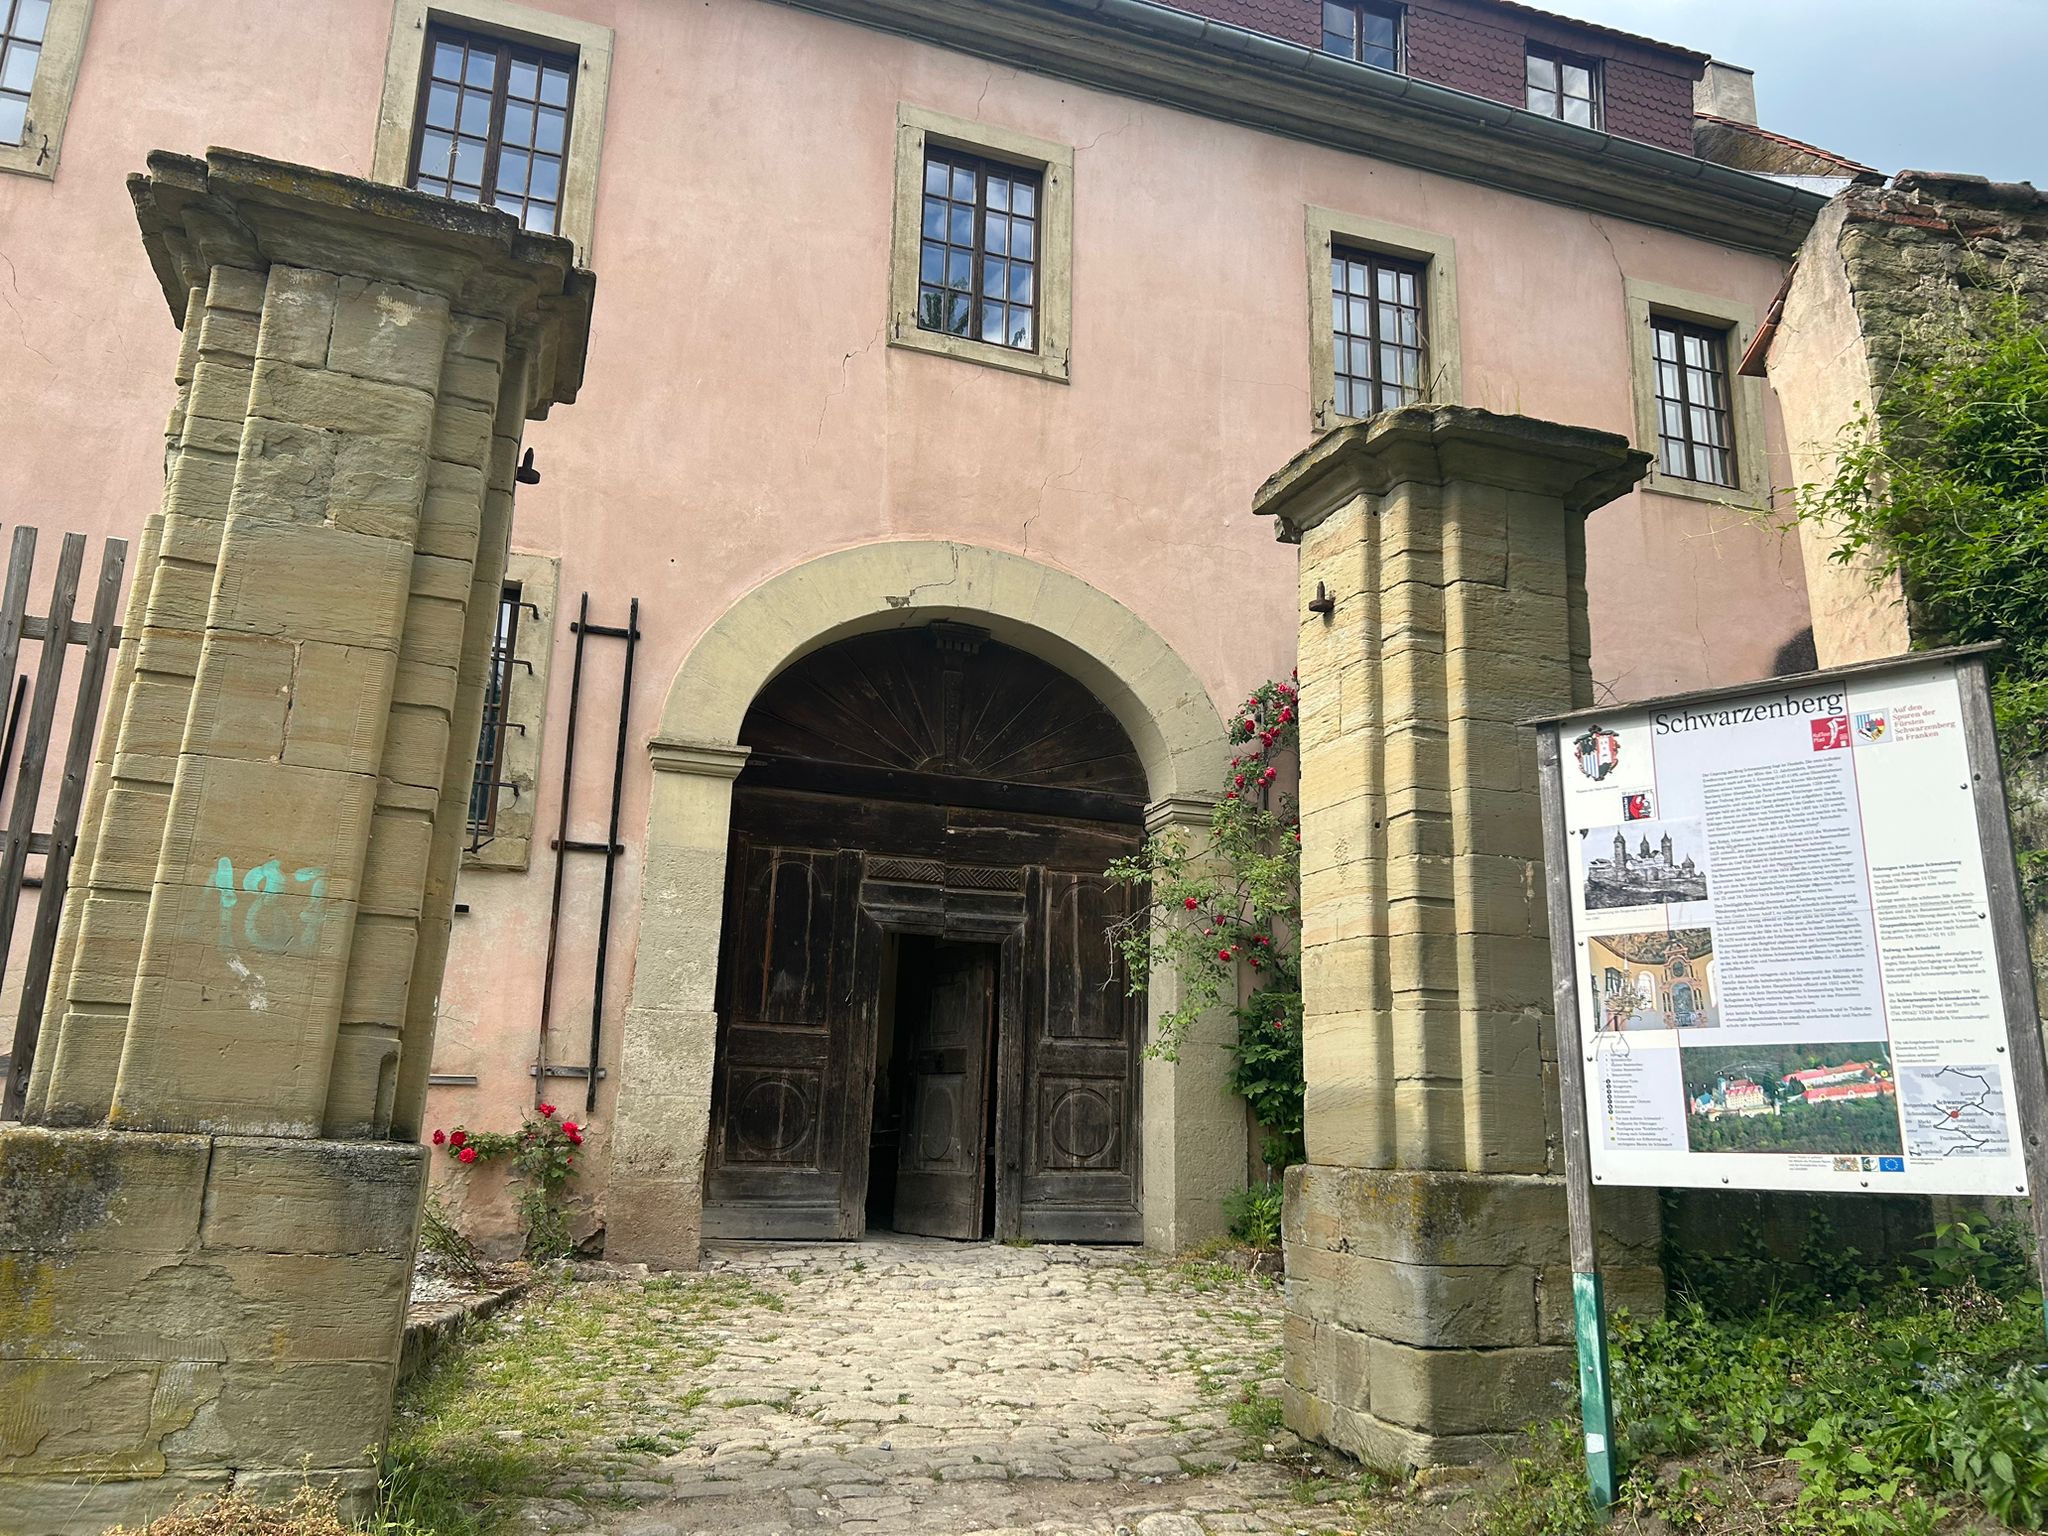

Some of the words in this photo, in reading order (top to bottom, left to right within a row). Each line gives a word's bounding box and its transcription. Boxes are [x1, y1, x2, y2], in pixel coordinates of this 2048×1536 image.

[1892, 705, 1906, 713] Auf
[1655, 693, 1844, 735] Schwarzenberg
[1892, 712, 1920, 721] Spuren
[1894, 718, 1925, 727] Fürsten
[1895, 721, 1956, 734] Schwarzenberg
[1906, 731, 1939, 740] Franken
